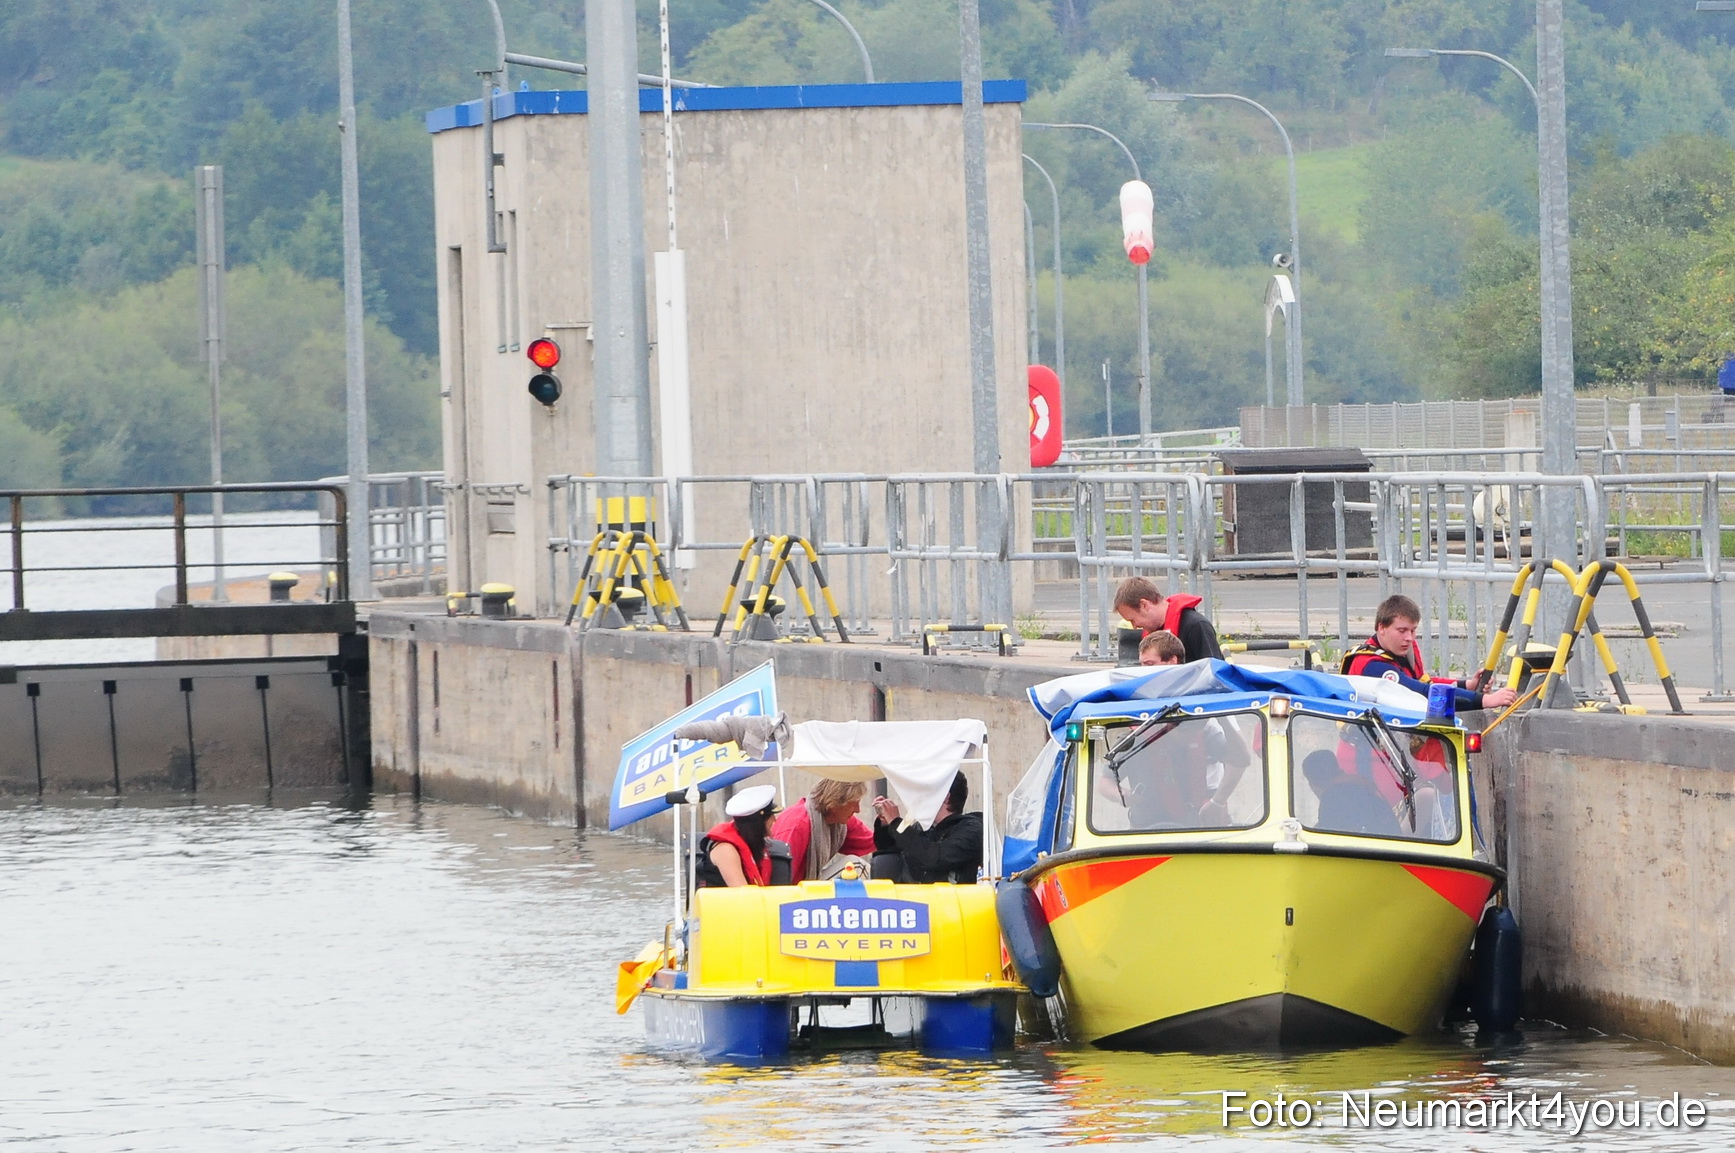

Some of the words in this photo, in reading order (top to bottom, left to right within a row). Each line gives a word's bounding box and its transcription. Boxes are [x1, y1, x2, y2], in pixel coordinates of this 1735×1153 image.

[633, 745, 747, 796] BAER
[793, 905, 917, 929] antenne
[794, 939, 917, 949] BAYERN
